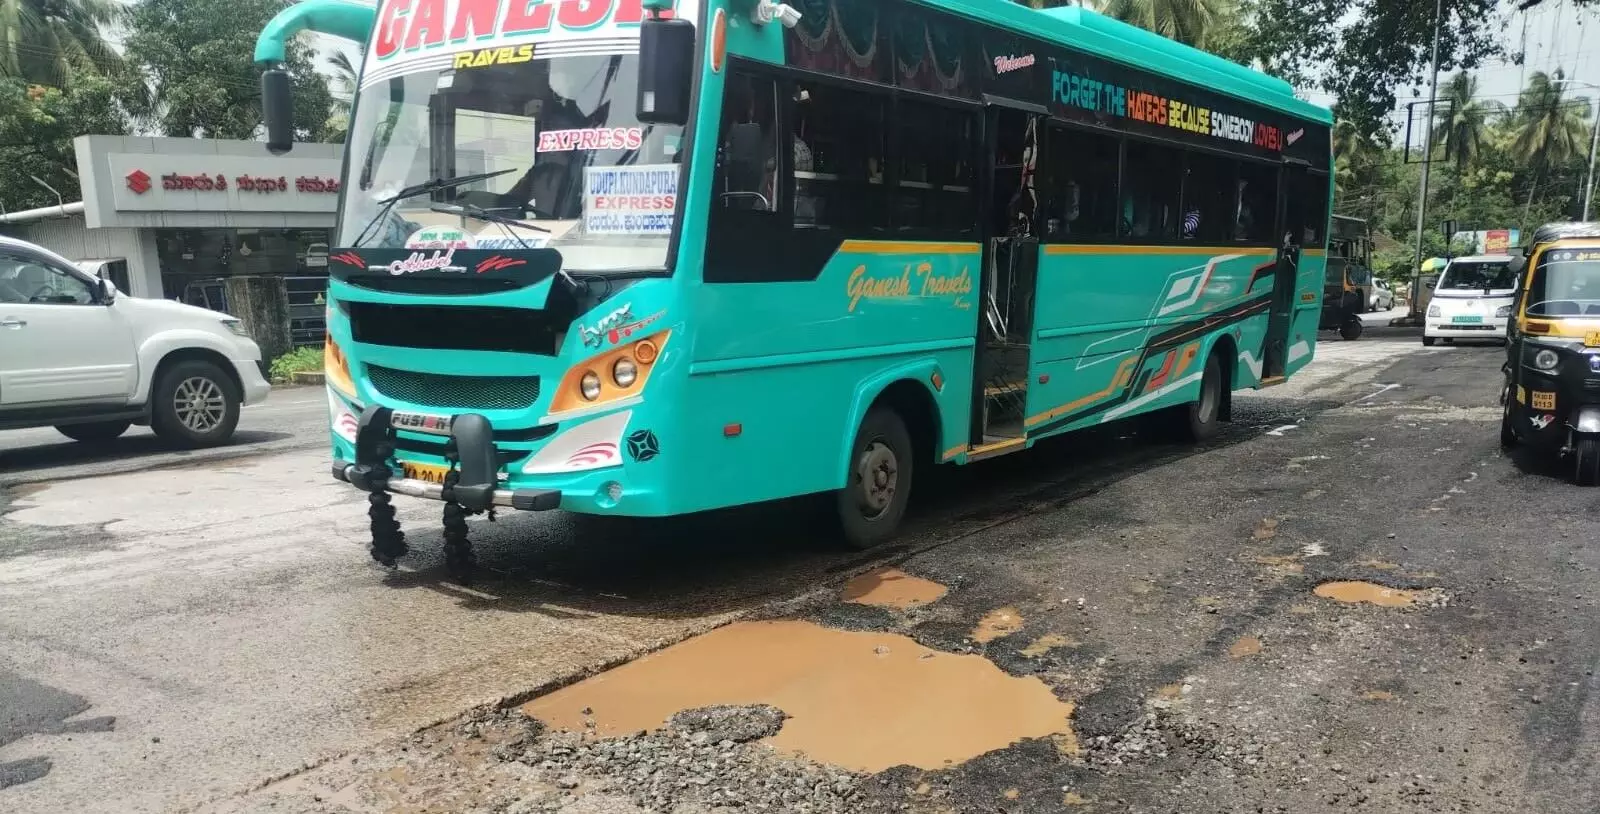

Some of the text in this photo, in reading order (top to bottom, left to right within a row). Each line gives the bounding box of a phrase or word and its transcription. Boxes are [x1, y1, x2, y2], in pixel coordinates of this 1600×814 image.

[453, 43, 534, 69] TRAVELS
[994, 54, 1035, 74] Welcome
[1052, 70, 1102, 111] FORGET
[1105, 85, 1125, 117] THE
[1127, 89, 1167, 125] HATERS
[1169, 100, 1210, 135] BECAUSE
[1211, 111, 1254, 145] SOMEBODY
[537, 127, 643, 153] EXPRESS
[595, 196, 674, 210] EXPRESS
[847, 263, 972, 312] Ganesh Travels
